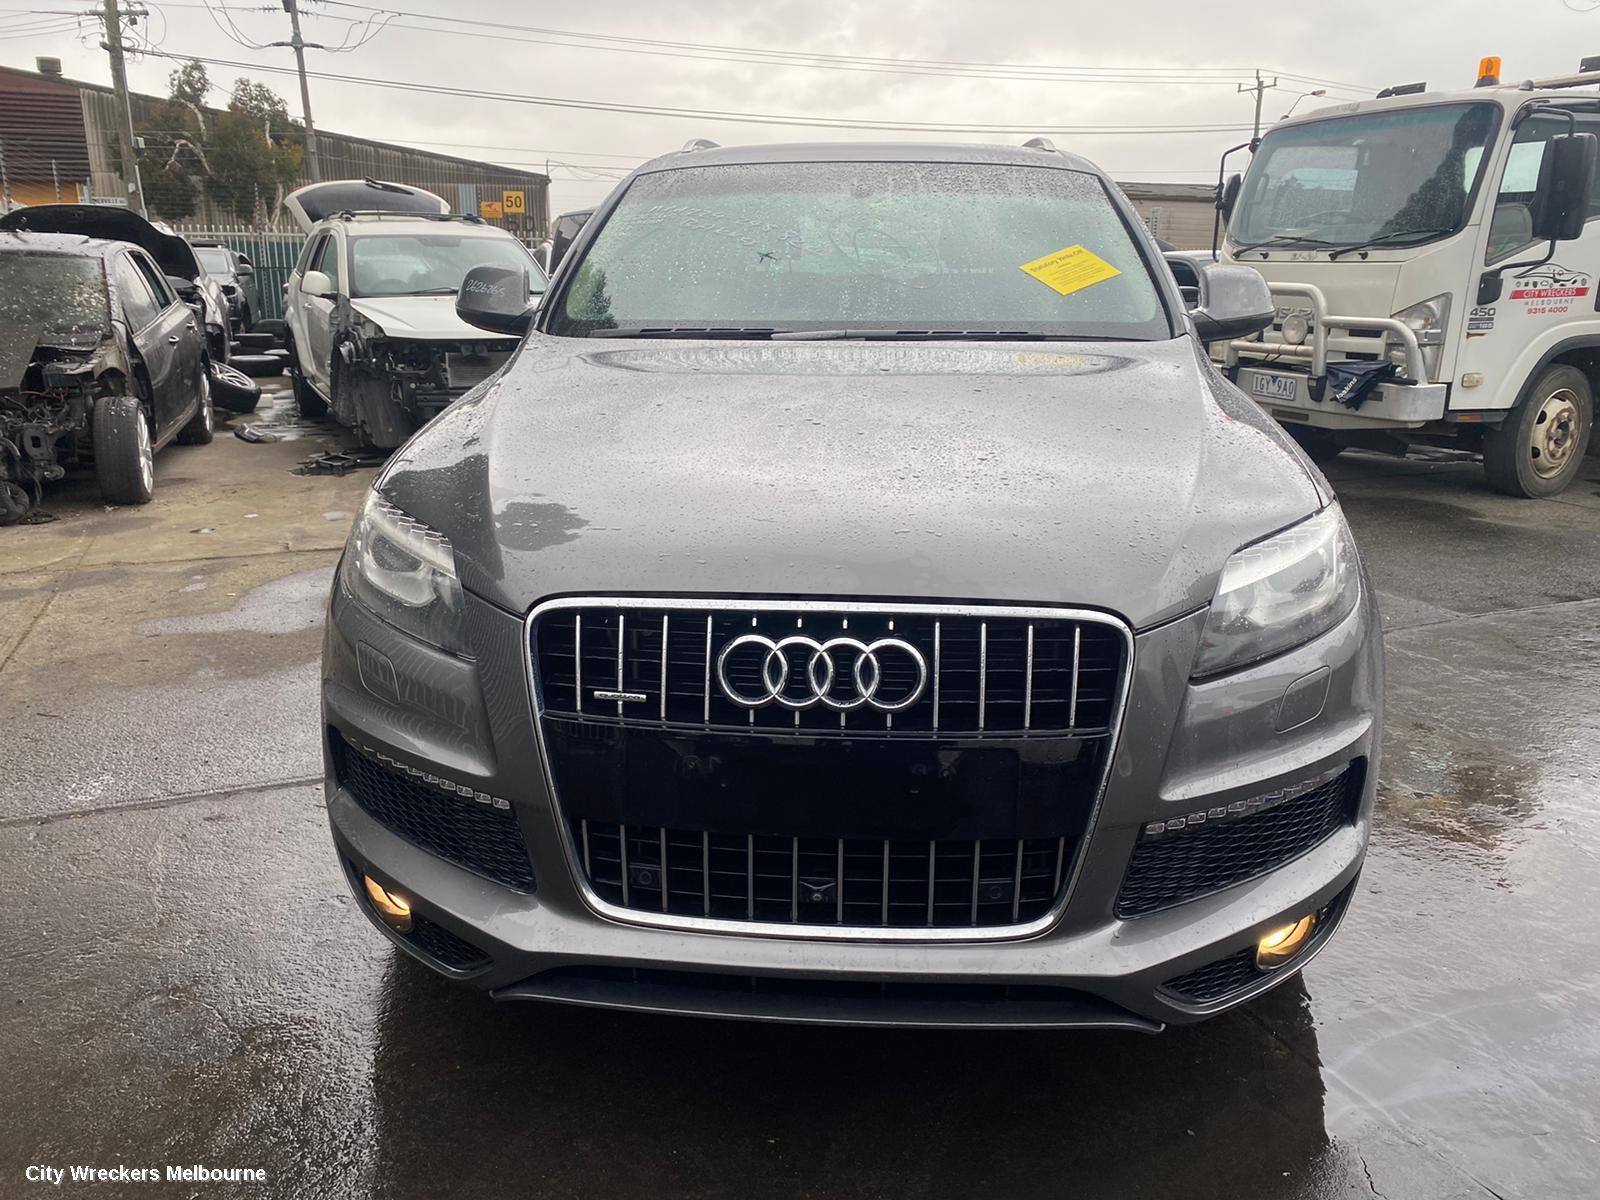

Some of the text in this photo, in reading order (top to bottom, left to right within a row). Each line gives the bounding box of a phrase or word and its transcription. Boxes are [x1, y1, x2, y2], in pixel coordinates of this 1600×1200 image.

[505, 195, 523, 209] 50
[1523, 287, 1577, 298] CITY WRECKERS
[1470, 307, 1497, 317] 450
[1527, 306, 1568, 315] 9315 4000
